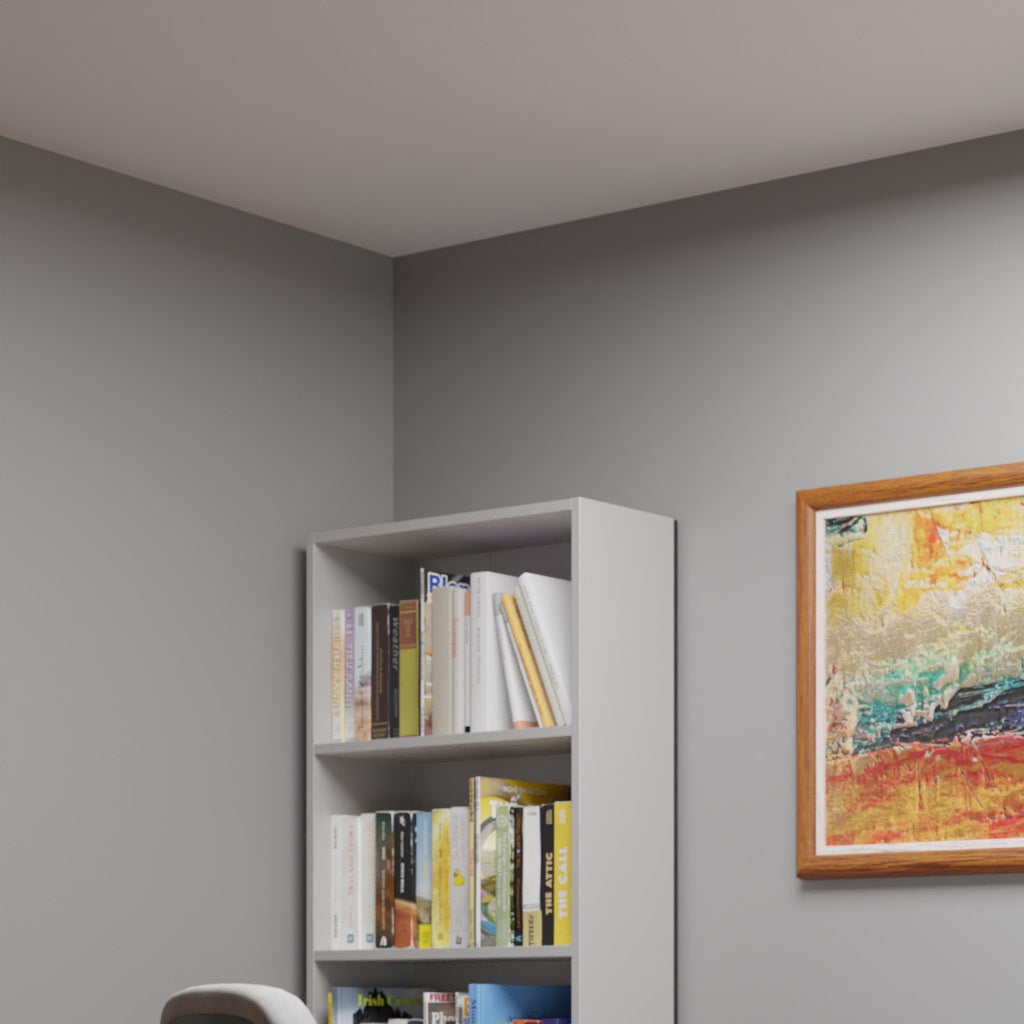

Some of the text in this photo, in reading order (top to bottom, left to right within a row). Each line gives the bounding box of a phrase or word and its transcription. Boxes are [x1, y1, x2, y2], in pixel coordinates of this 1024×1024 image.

[545, 852, 553, 915] THE ATTIC
[558, 847, 568, 919] THE CALL
[357, 993, 385, 1007] Irish
[429, 993, 451, 1002] FREE
